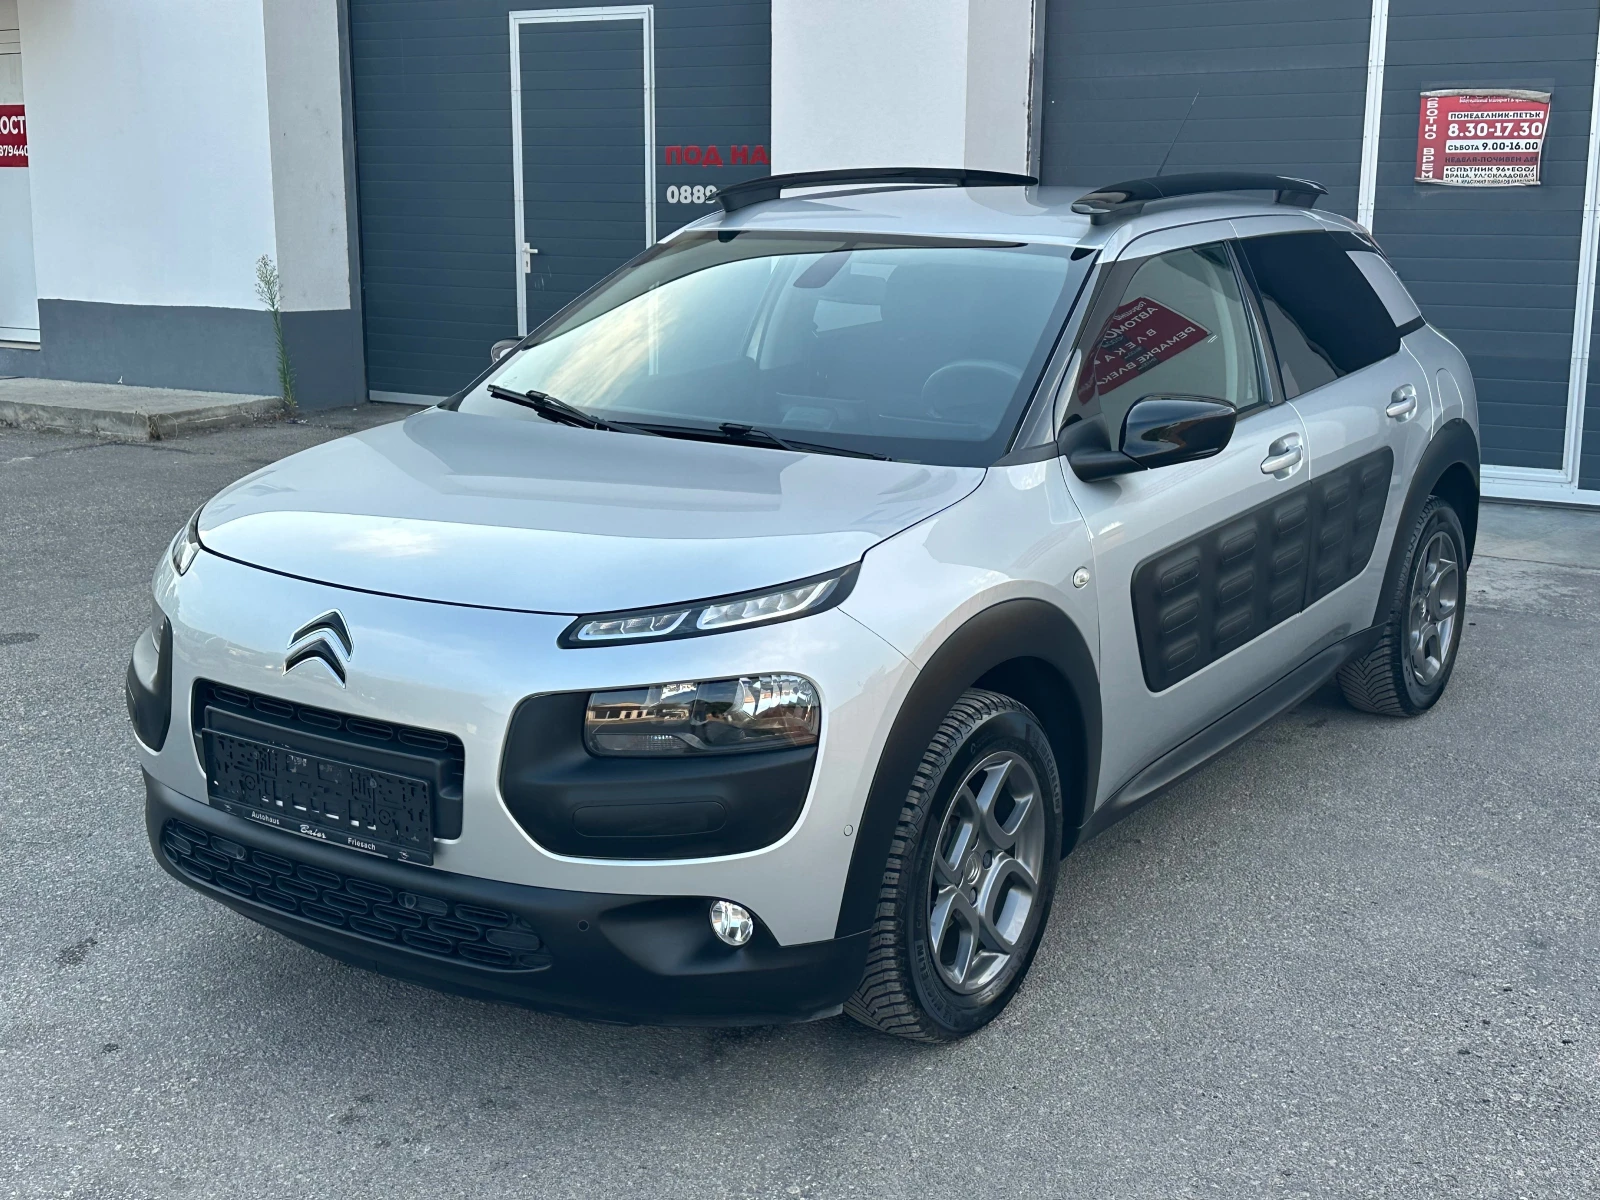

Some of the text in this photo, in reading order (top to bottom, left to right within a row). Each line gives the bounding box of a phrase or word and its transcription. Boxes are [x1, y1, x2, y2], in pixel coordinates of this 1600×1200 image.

[0, 115, 25, 134] ОСТ
[1448, 122, 1543, 137] 8.30-17.30
[1482, 142, 1538, 151] 9.00-16.00
[665, 145, 769, 168] ПОД НА
[251, 811, 280, 825] Autohaus
[347, 837, 376, 851] Friesach
